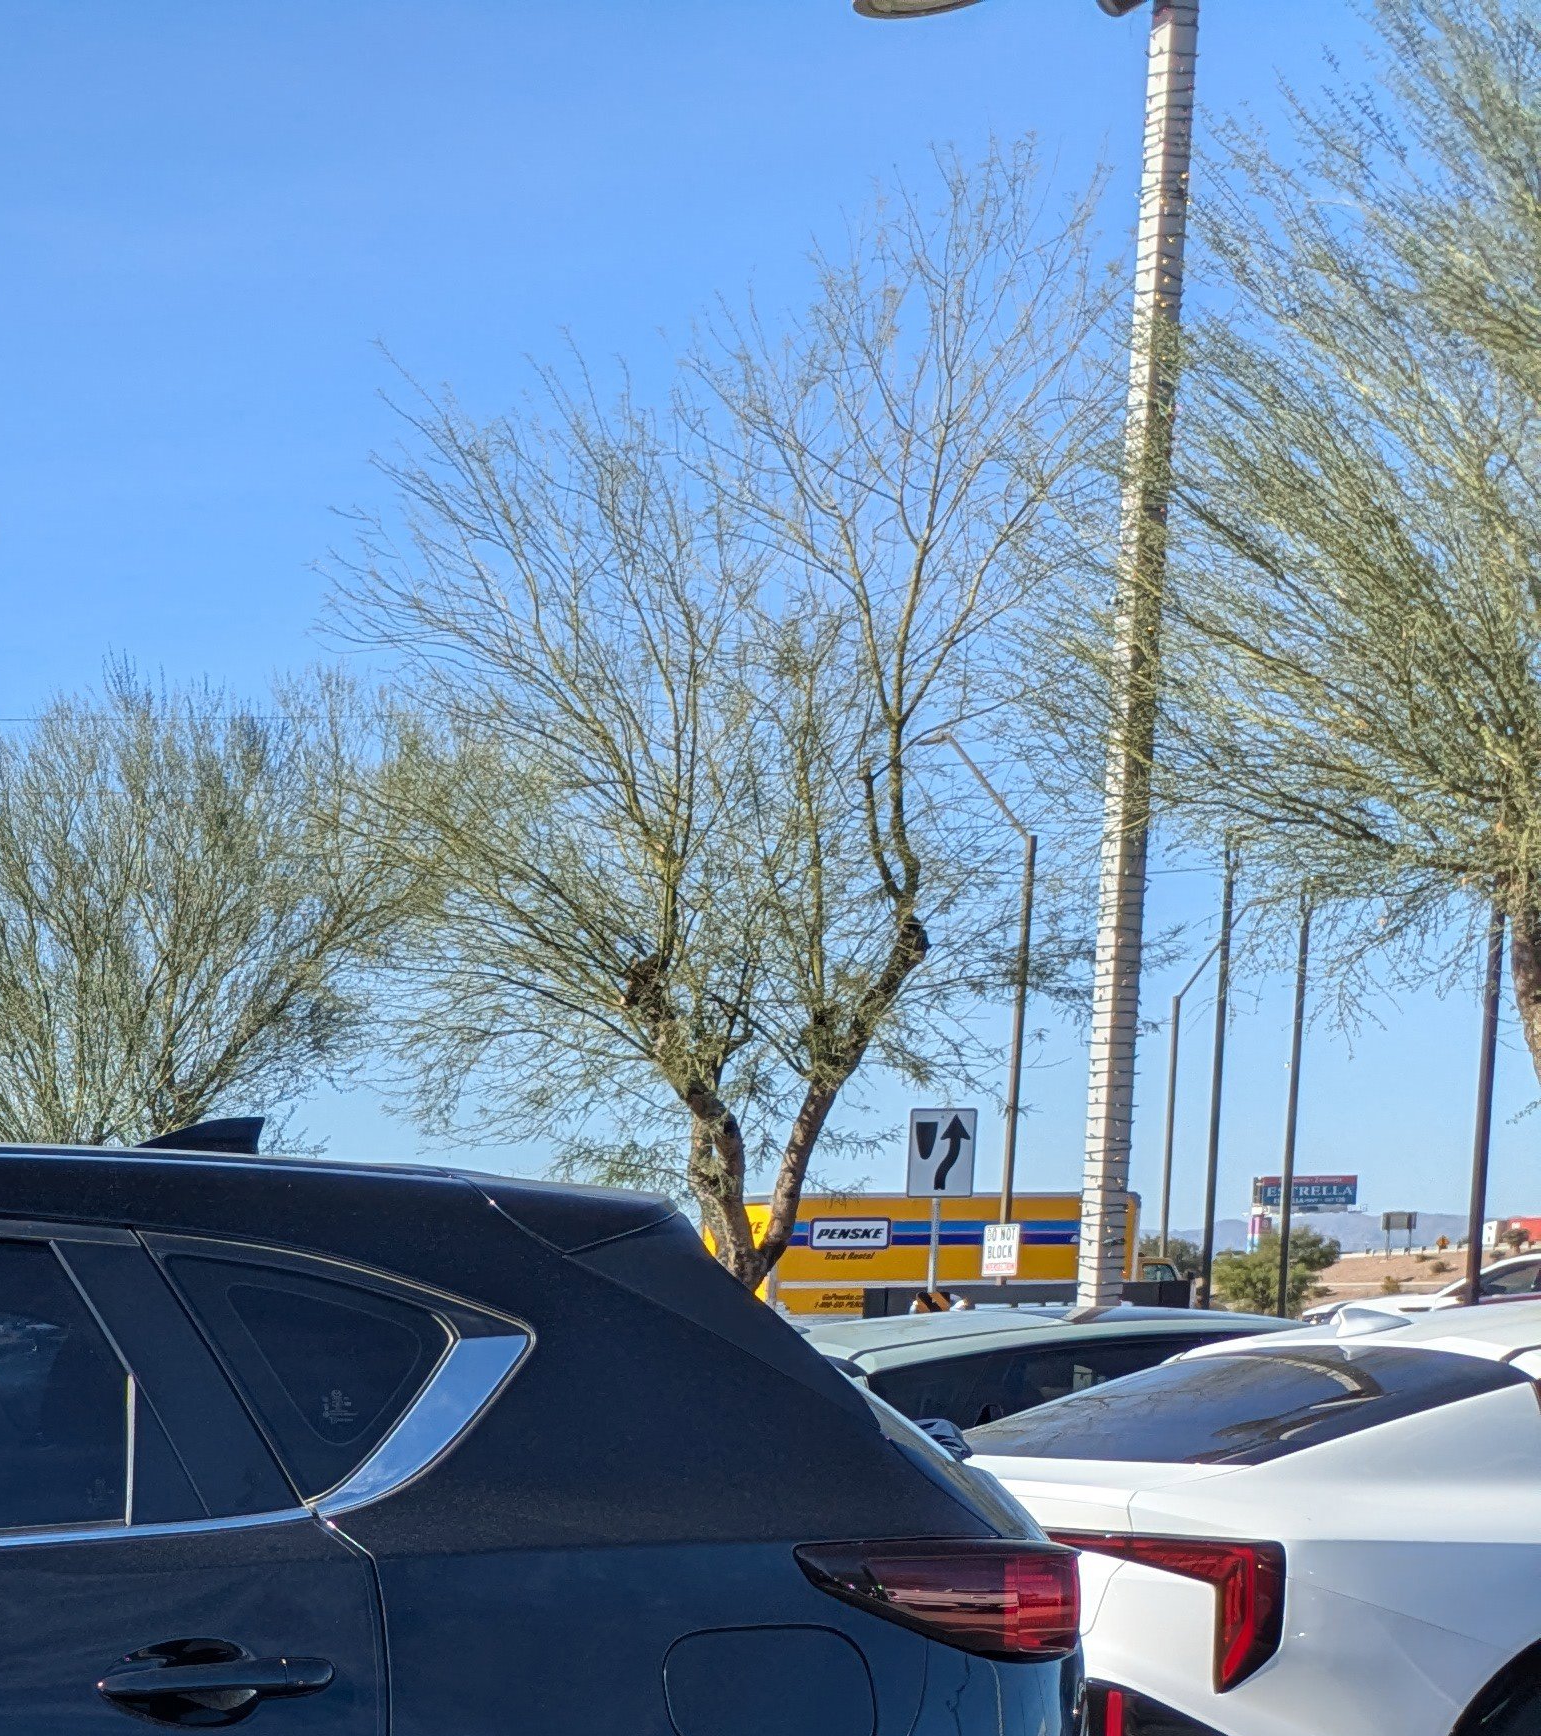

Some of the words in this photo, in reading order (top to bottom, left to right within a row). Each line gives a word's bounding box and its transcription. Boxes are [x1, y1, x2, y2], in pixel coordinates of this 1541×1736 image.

[1267, 1186, 1353, 1197] ERELLA
[816, 1228, 884, 1240] PENSKE
[987, 1227, 997, 1241] DO
[1000, 1227, 1016, 1241] NOT
[824, 1251, 846, 1260] Truck
[847, 1251, 876, 1260] Rental
[987, 1244, 1013, 1259] BLOCK
